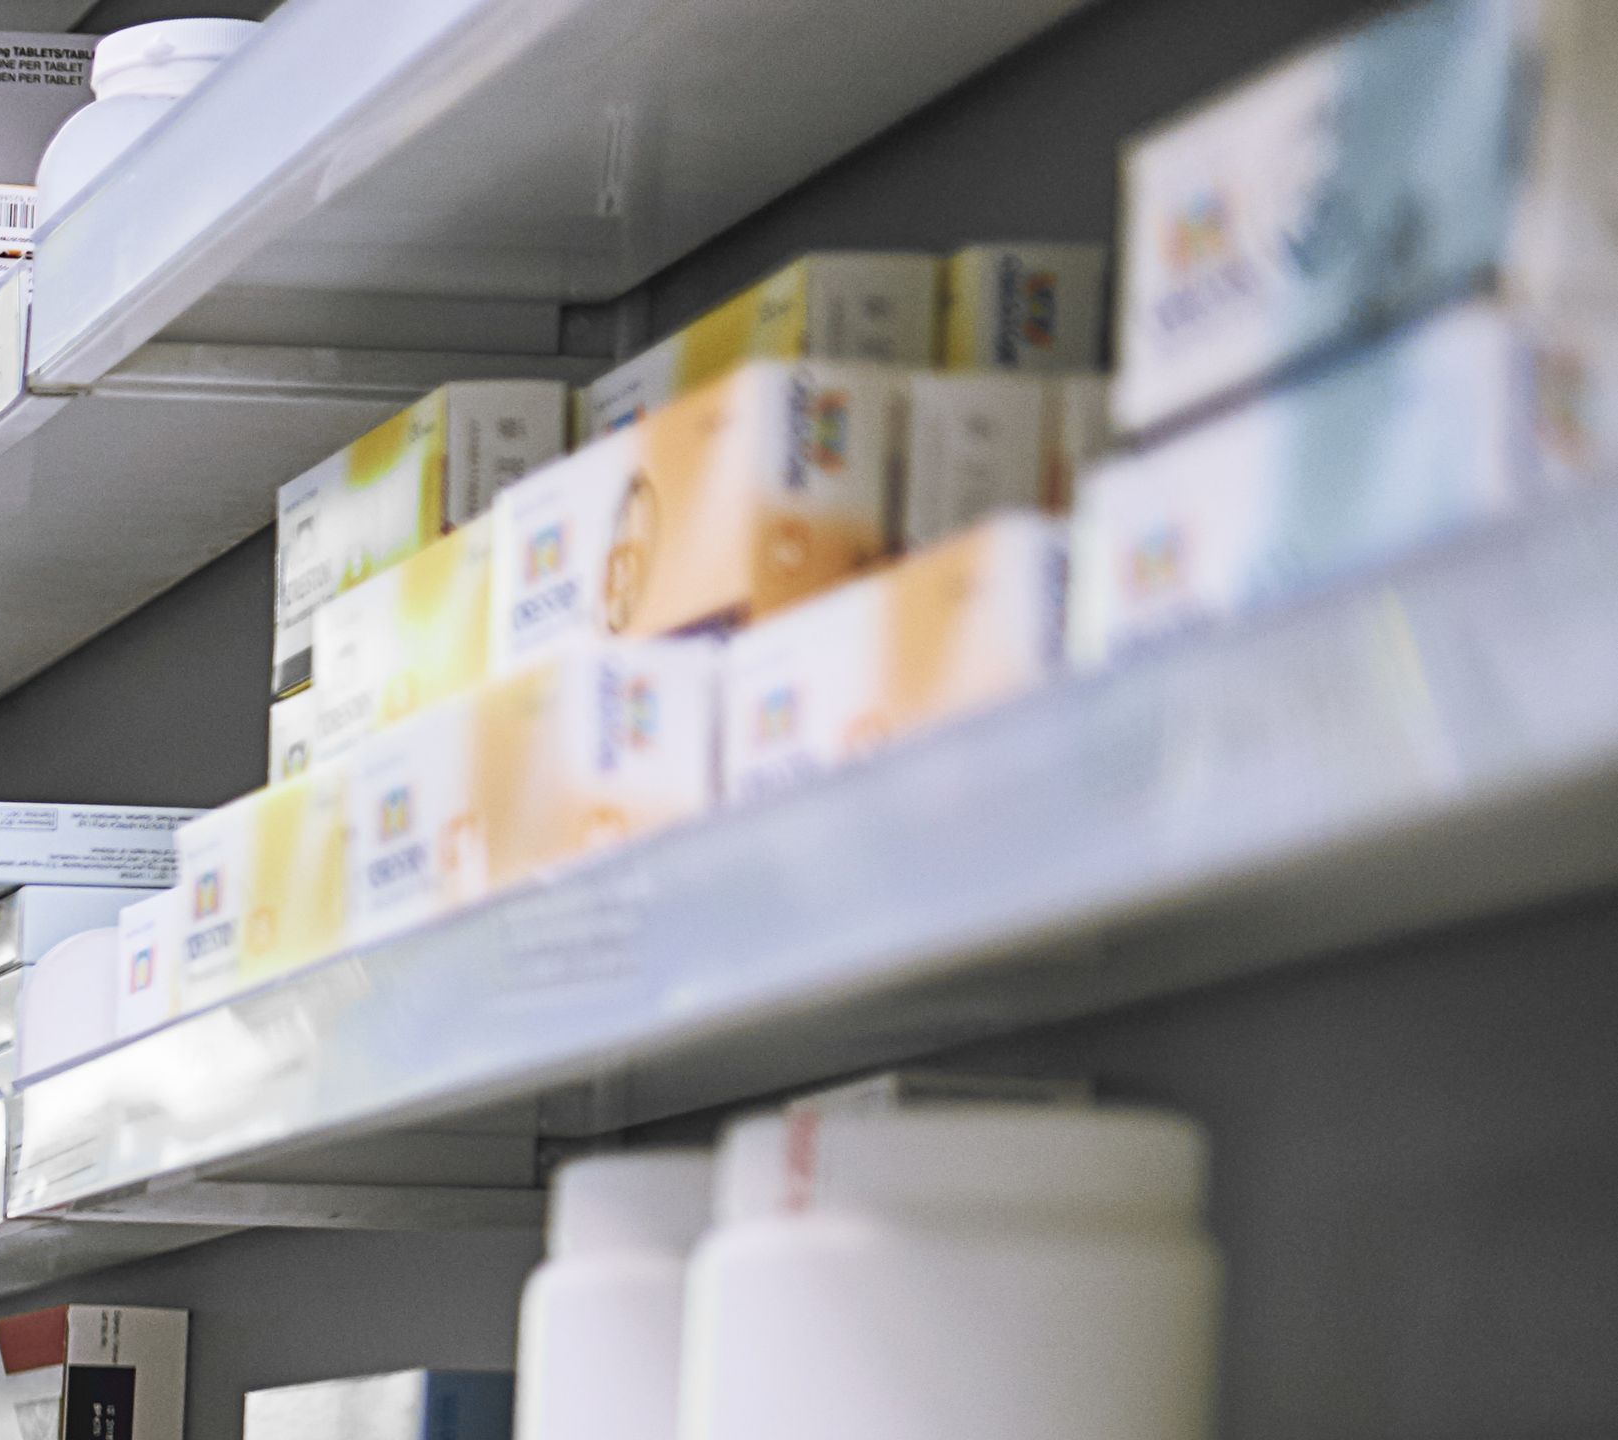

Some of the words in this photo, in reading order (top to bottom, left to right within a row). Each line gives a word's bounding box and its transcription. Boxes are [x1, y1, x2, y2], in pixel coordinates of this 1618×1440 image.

[12, 44, 95, 60] TABLETS/TABL
[19, 60, 41, 71] PER
[44, 60, 83, 73] TABLET
[19, 73, 41, 84] PER
[44, 74, 83, 86] TABLET
